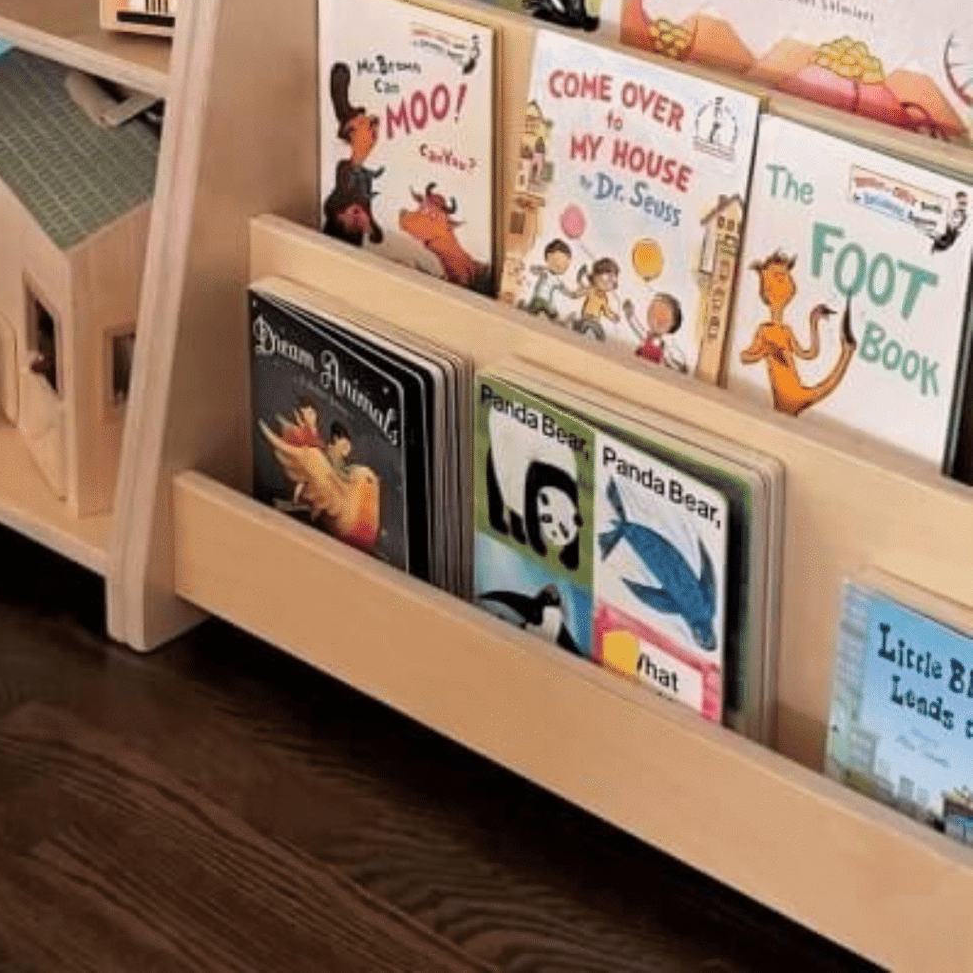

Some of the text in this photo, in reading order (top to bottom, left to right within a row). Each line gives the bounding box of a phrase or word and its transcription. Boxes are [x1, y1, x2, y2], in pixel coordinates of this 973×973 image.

[386, 83, 468, 140] MOO!
[548, 70, 614, 102] COME
[620, 81, 685, 132] OVER
[606, 110, 624, 131] to
[570, 132, 694, 193] MY HOUSE
[766, 163, 815, 205] The
[594, 172, 624, 202] Dr.
[629, 180, 682, 227] Seuss
[811, 220, 939, 321] FOOT
[253, 313, 318, 372] Dream
[320, 349, 399, 446] Animals
[859, 320, 939, 397] BOOK
[480, 383, 590, 464] Panda Bear,
[603, 446, 722, 529] Panda Bear,
[877, 622, 943, 680] Little
[890, 674, 955, 731] Leads
